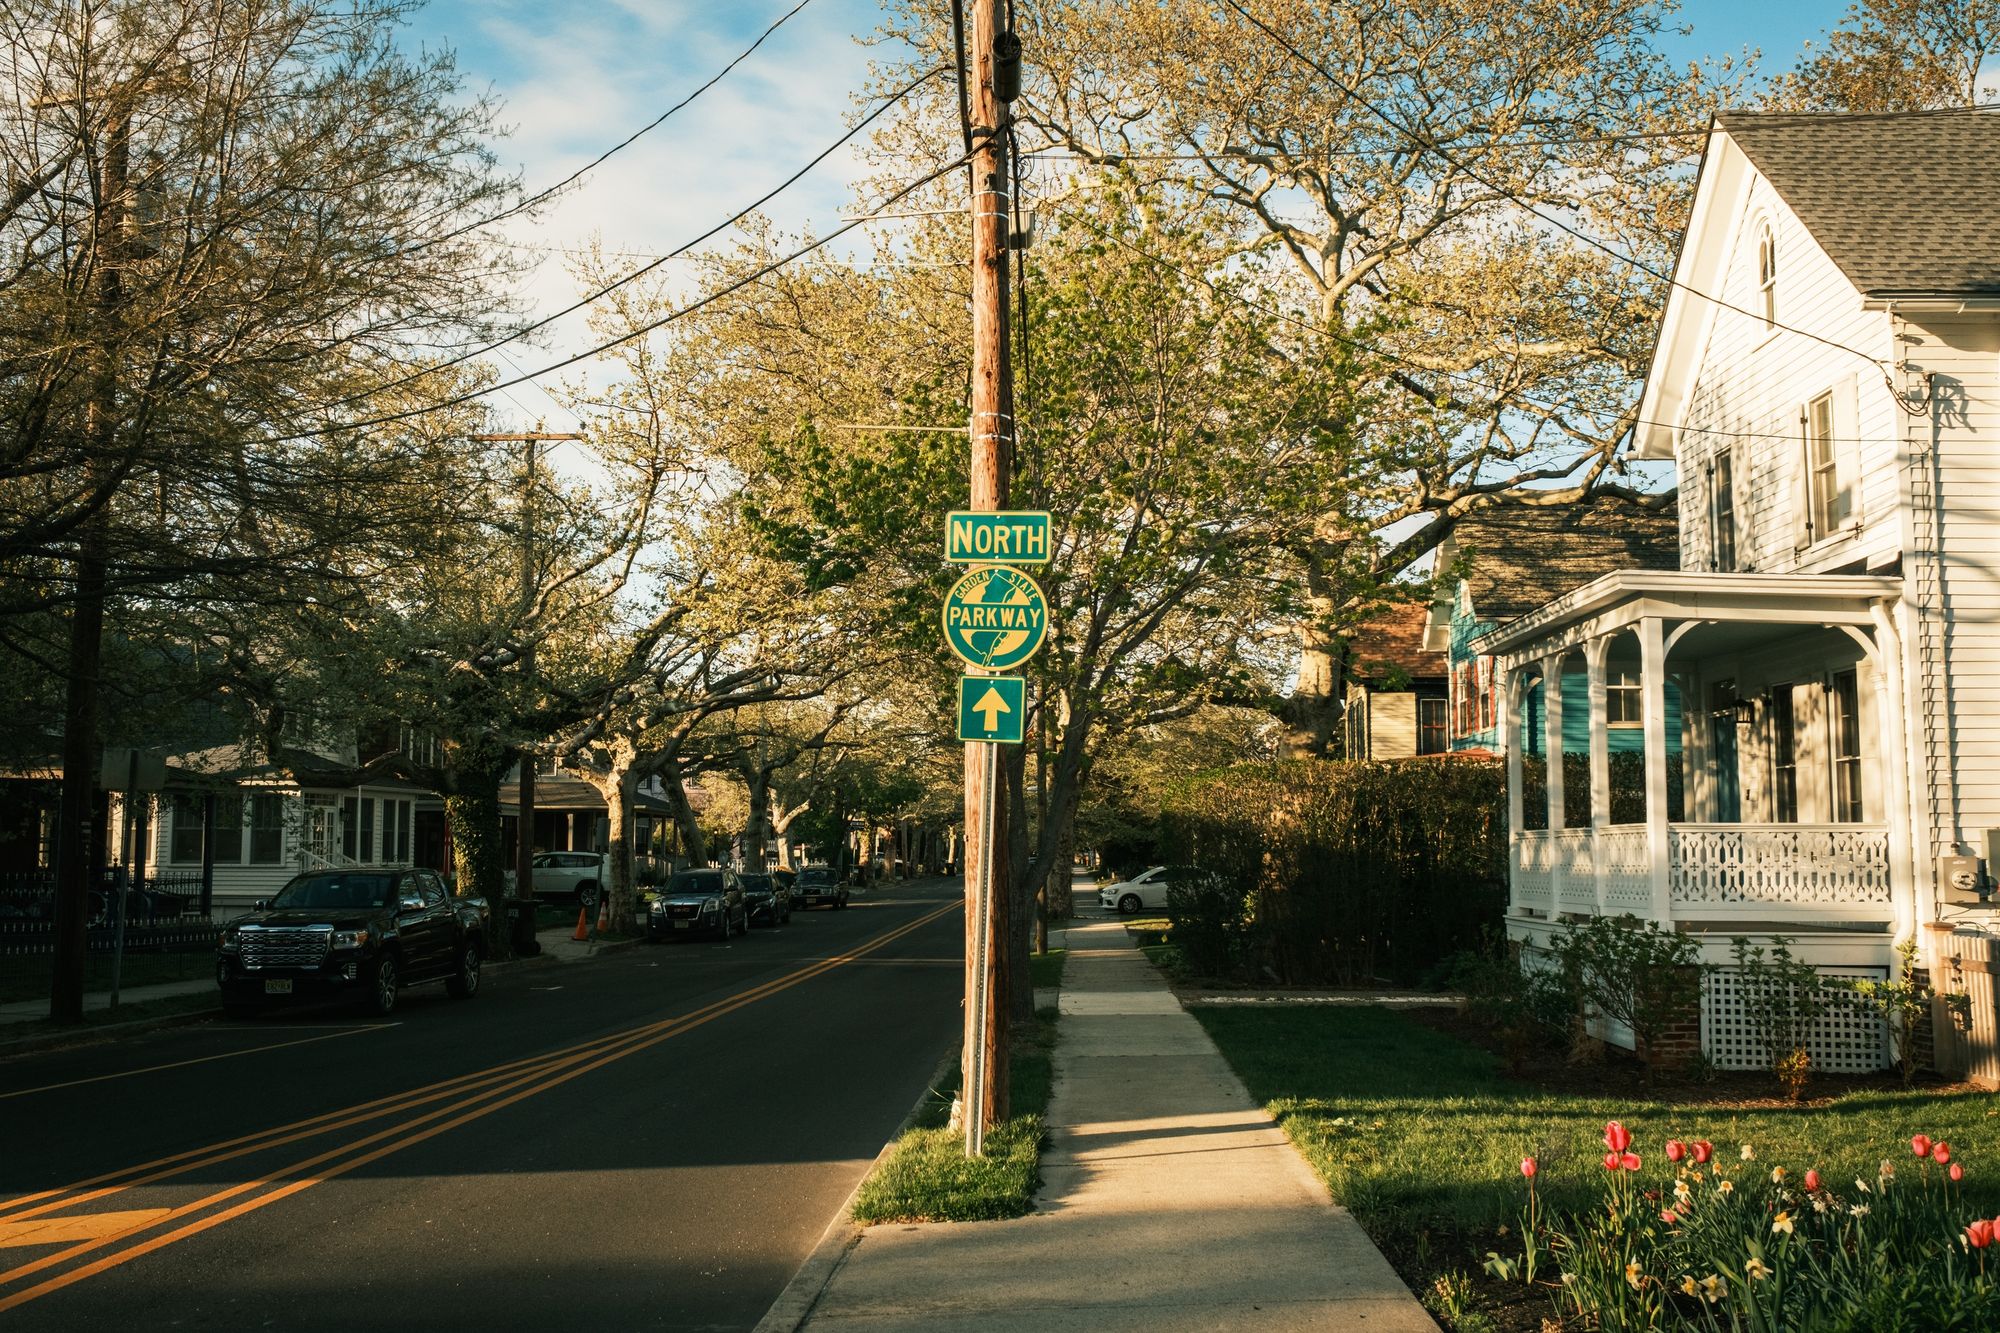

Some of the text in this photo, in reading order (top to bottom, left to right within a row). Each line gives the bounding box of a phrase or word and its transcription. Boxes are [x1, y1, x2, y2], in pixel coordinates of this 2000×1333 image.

[953, 521, 1044, 554] NORTH
[955, 571, 1039, 602] GARDEN STATE
[949, 606, 1041, 628] PARKWAY
